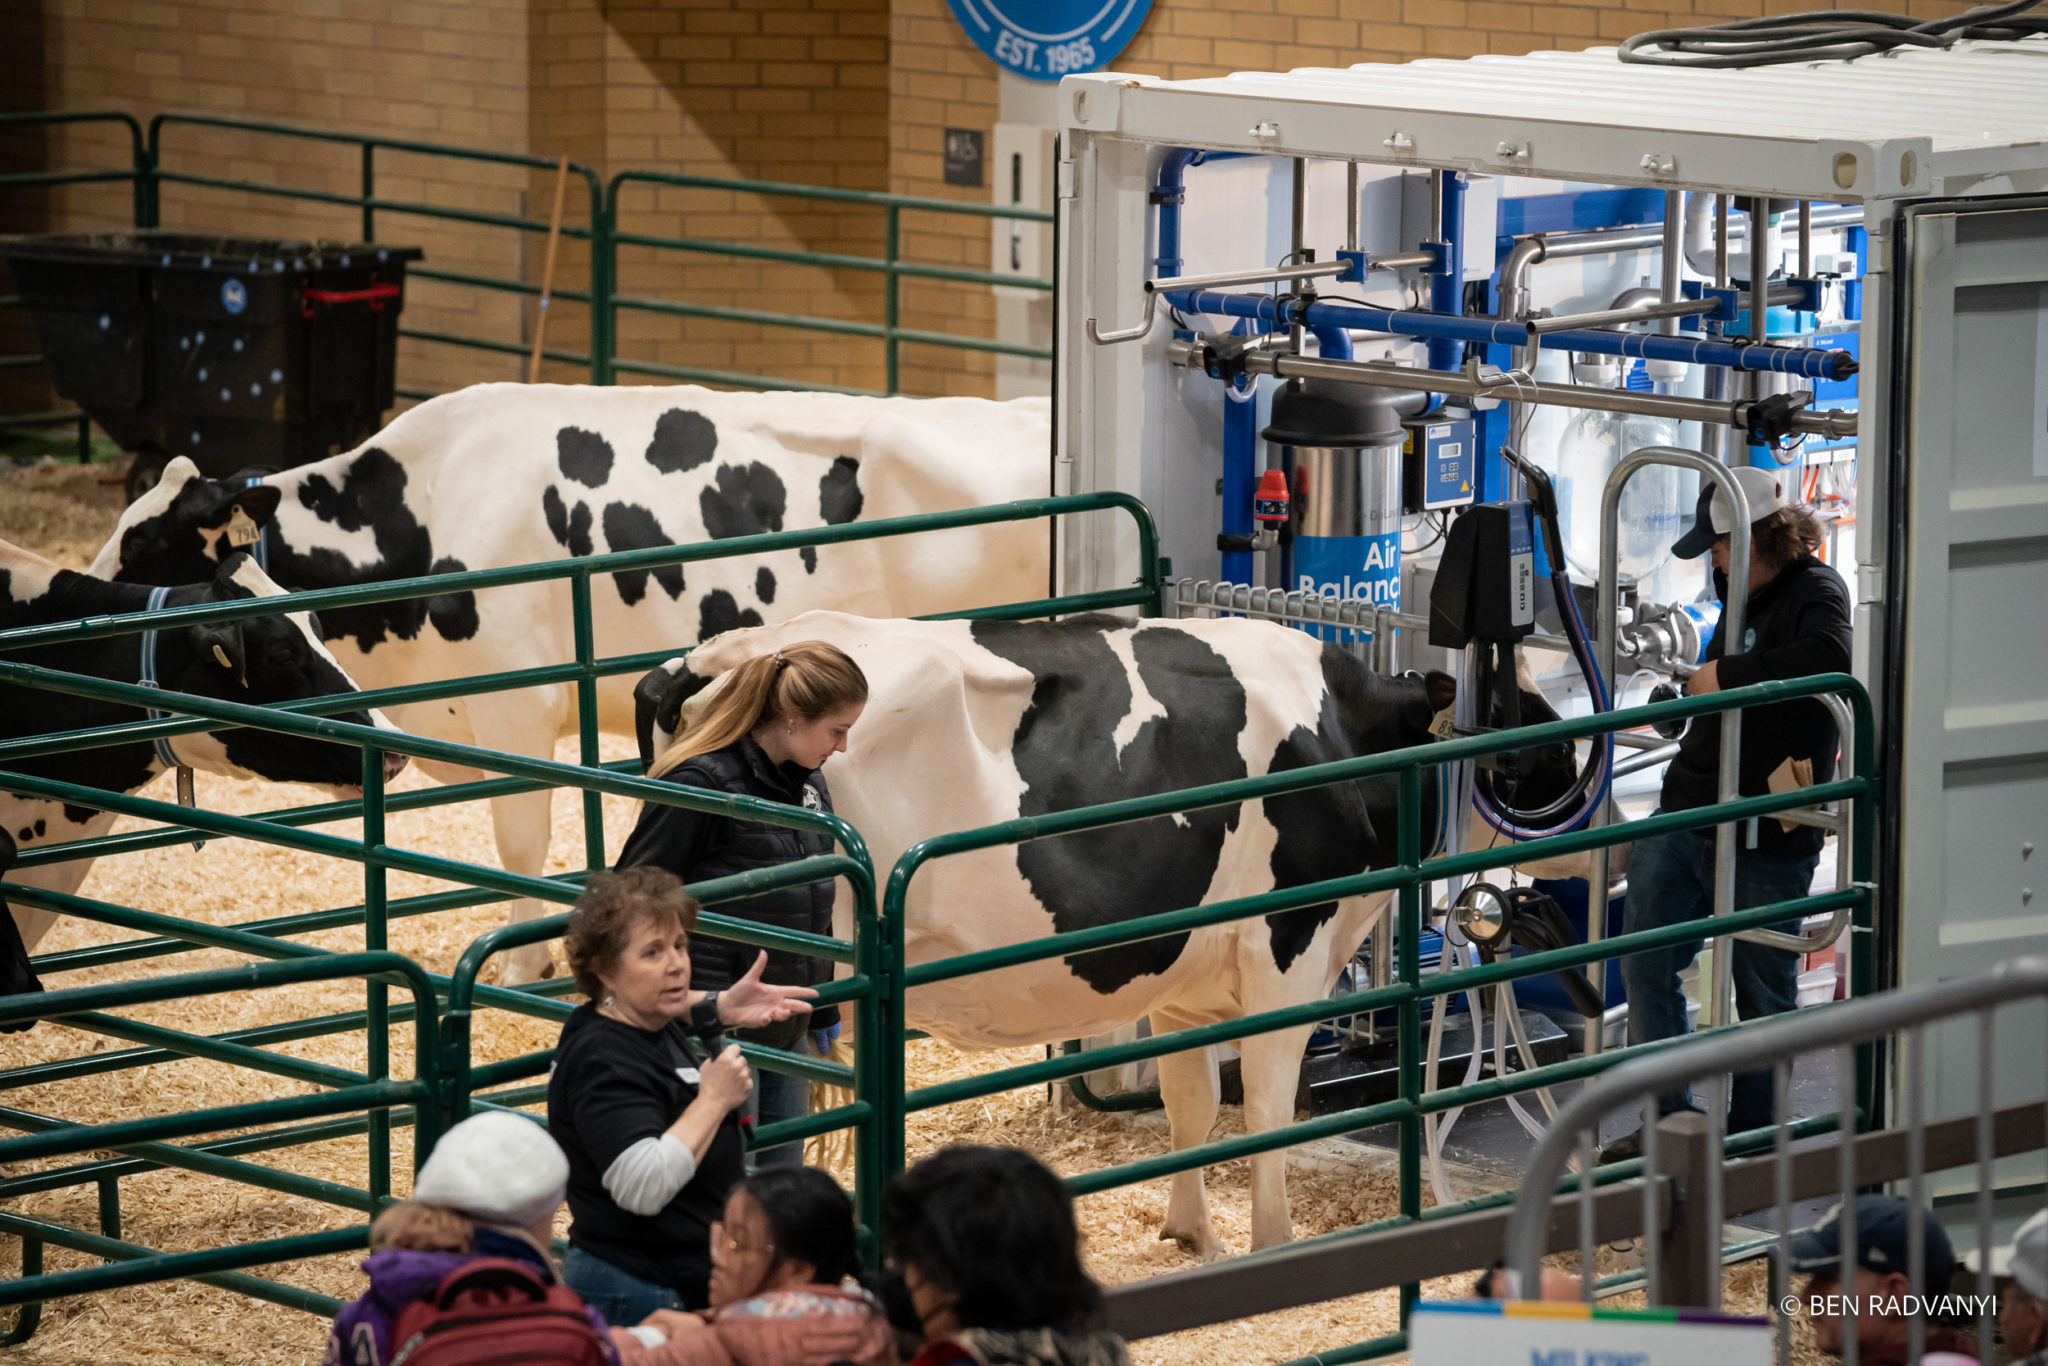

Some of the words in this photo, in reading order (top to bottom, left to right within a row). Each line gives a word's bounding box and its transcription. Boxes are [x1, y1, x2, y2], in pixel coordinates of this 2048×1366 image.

[995, 29, 1041, 72] EST.
[1045, 36, 1096, 73] 1965
[1363, 539, 1396, 572] Air
